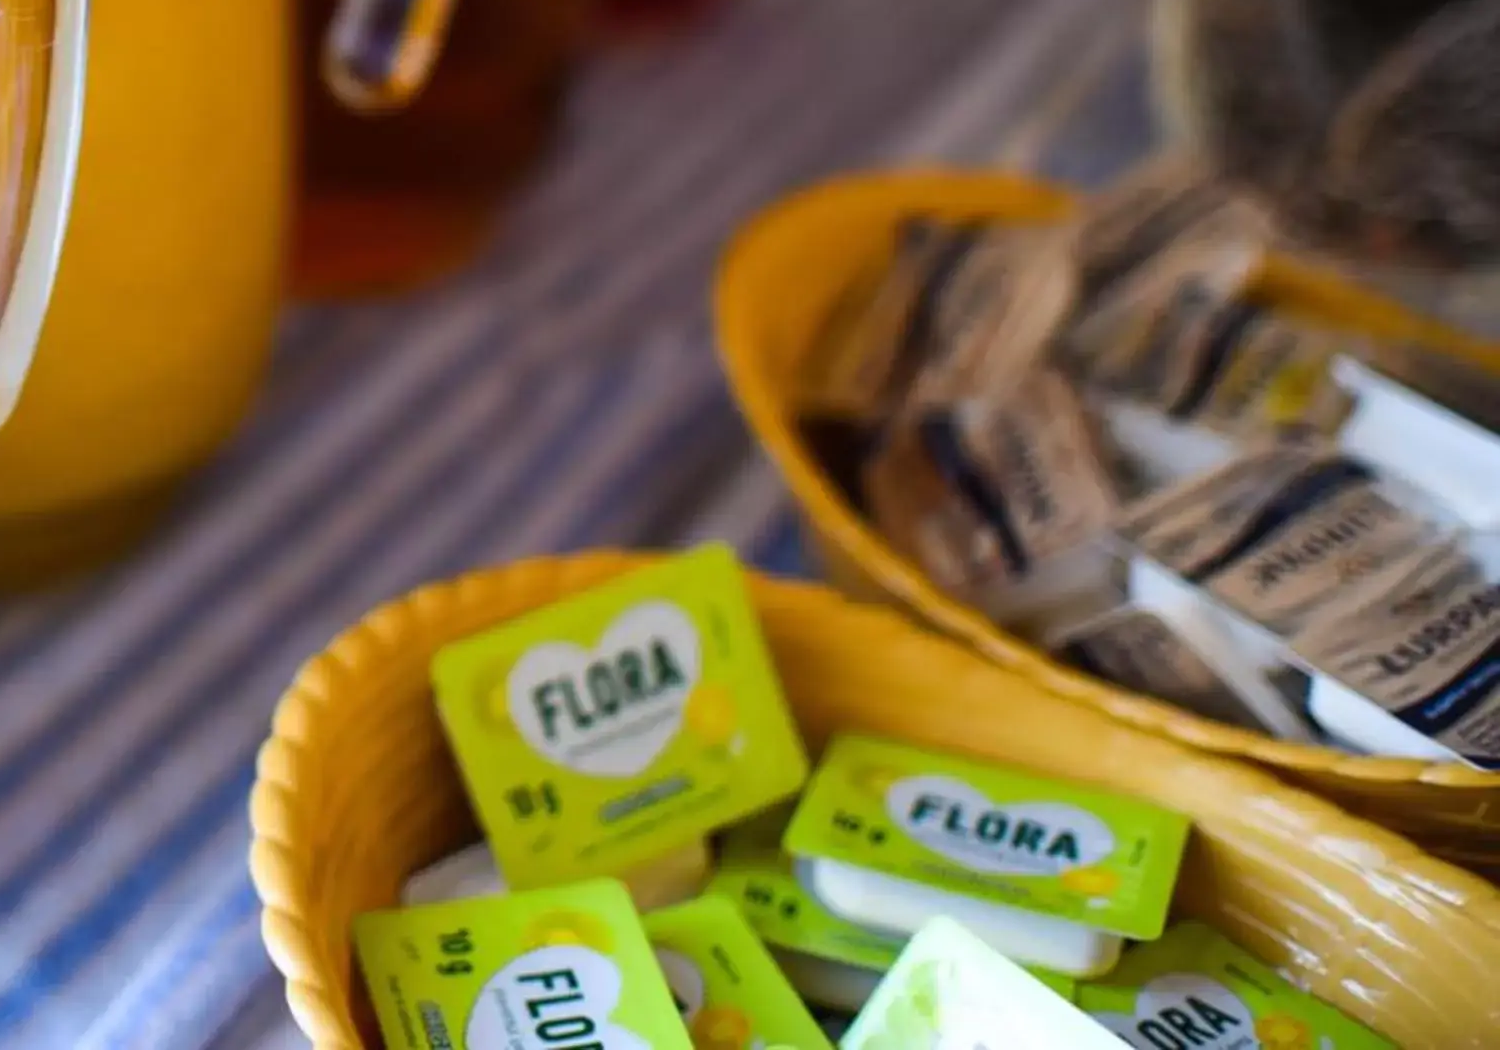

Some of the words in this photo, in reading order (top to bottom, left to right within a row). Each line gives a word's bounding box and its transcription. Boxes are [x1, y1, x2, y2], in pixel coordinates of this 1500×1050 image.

[531, 636, 687, 743] FLORA
[908, 793, 1080, 862] FLORA
[438, 926, 474, 956] 10
[516, 968, 604, 1050] FLO
[1118, 995, 1242, 1050] ORA
